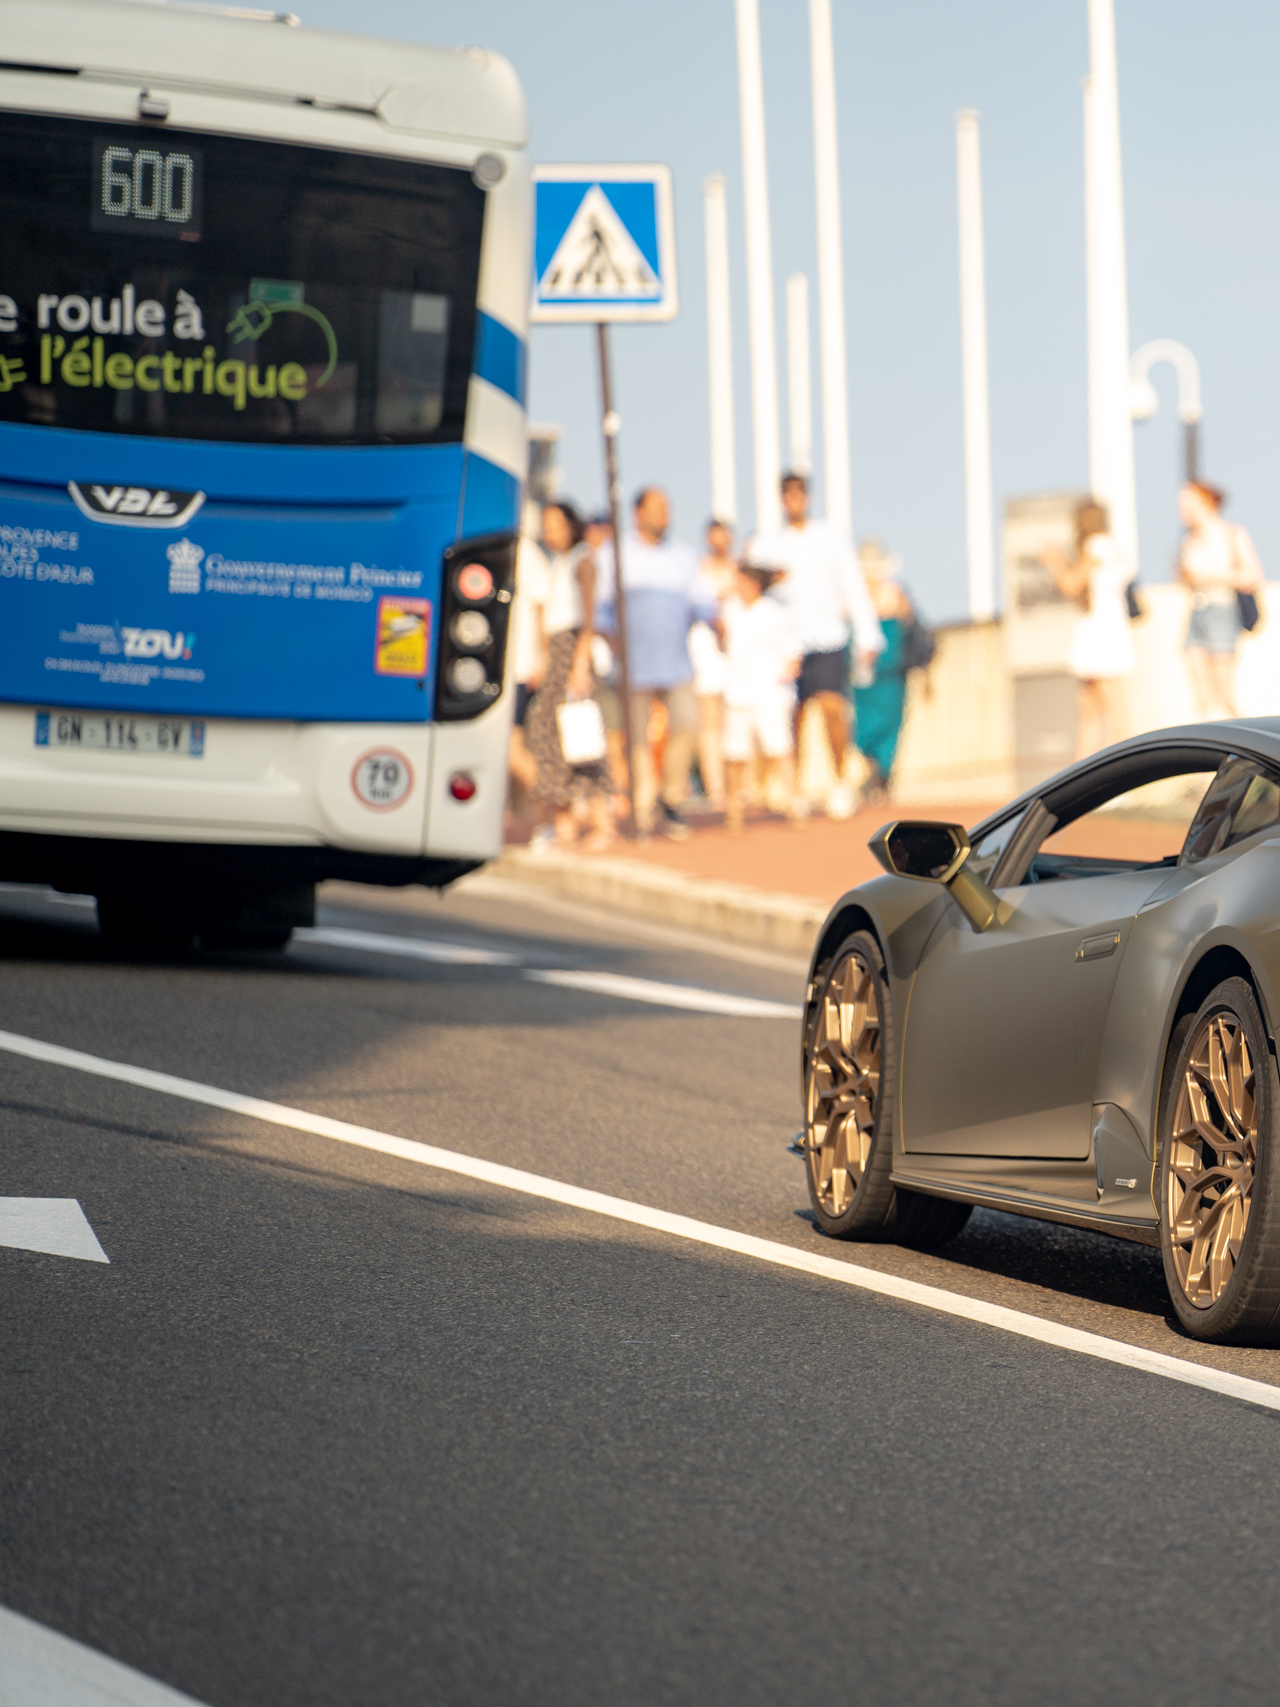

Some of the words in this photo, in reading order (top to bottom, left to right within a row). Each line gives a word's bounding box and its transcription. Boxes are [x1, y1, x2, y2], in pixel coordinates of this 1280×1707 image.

[102, 145, 194, 223] 600
[0, 294, 19, 333] e
[37, 283, 166, 338] roule
[172, 288, 206, 341] à
[40, 333, 309, 412] l'électrique
[90, 484, 180, 516] VDL
[367, 759, 400, 787] 70
